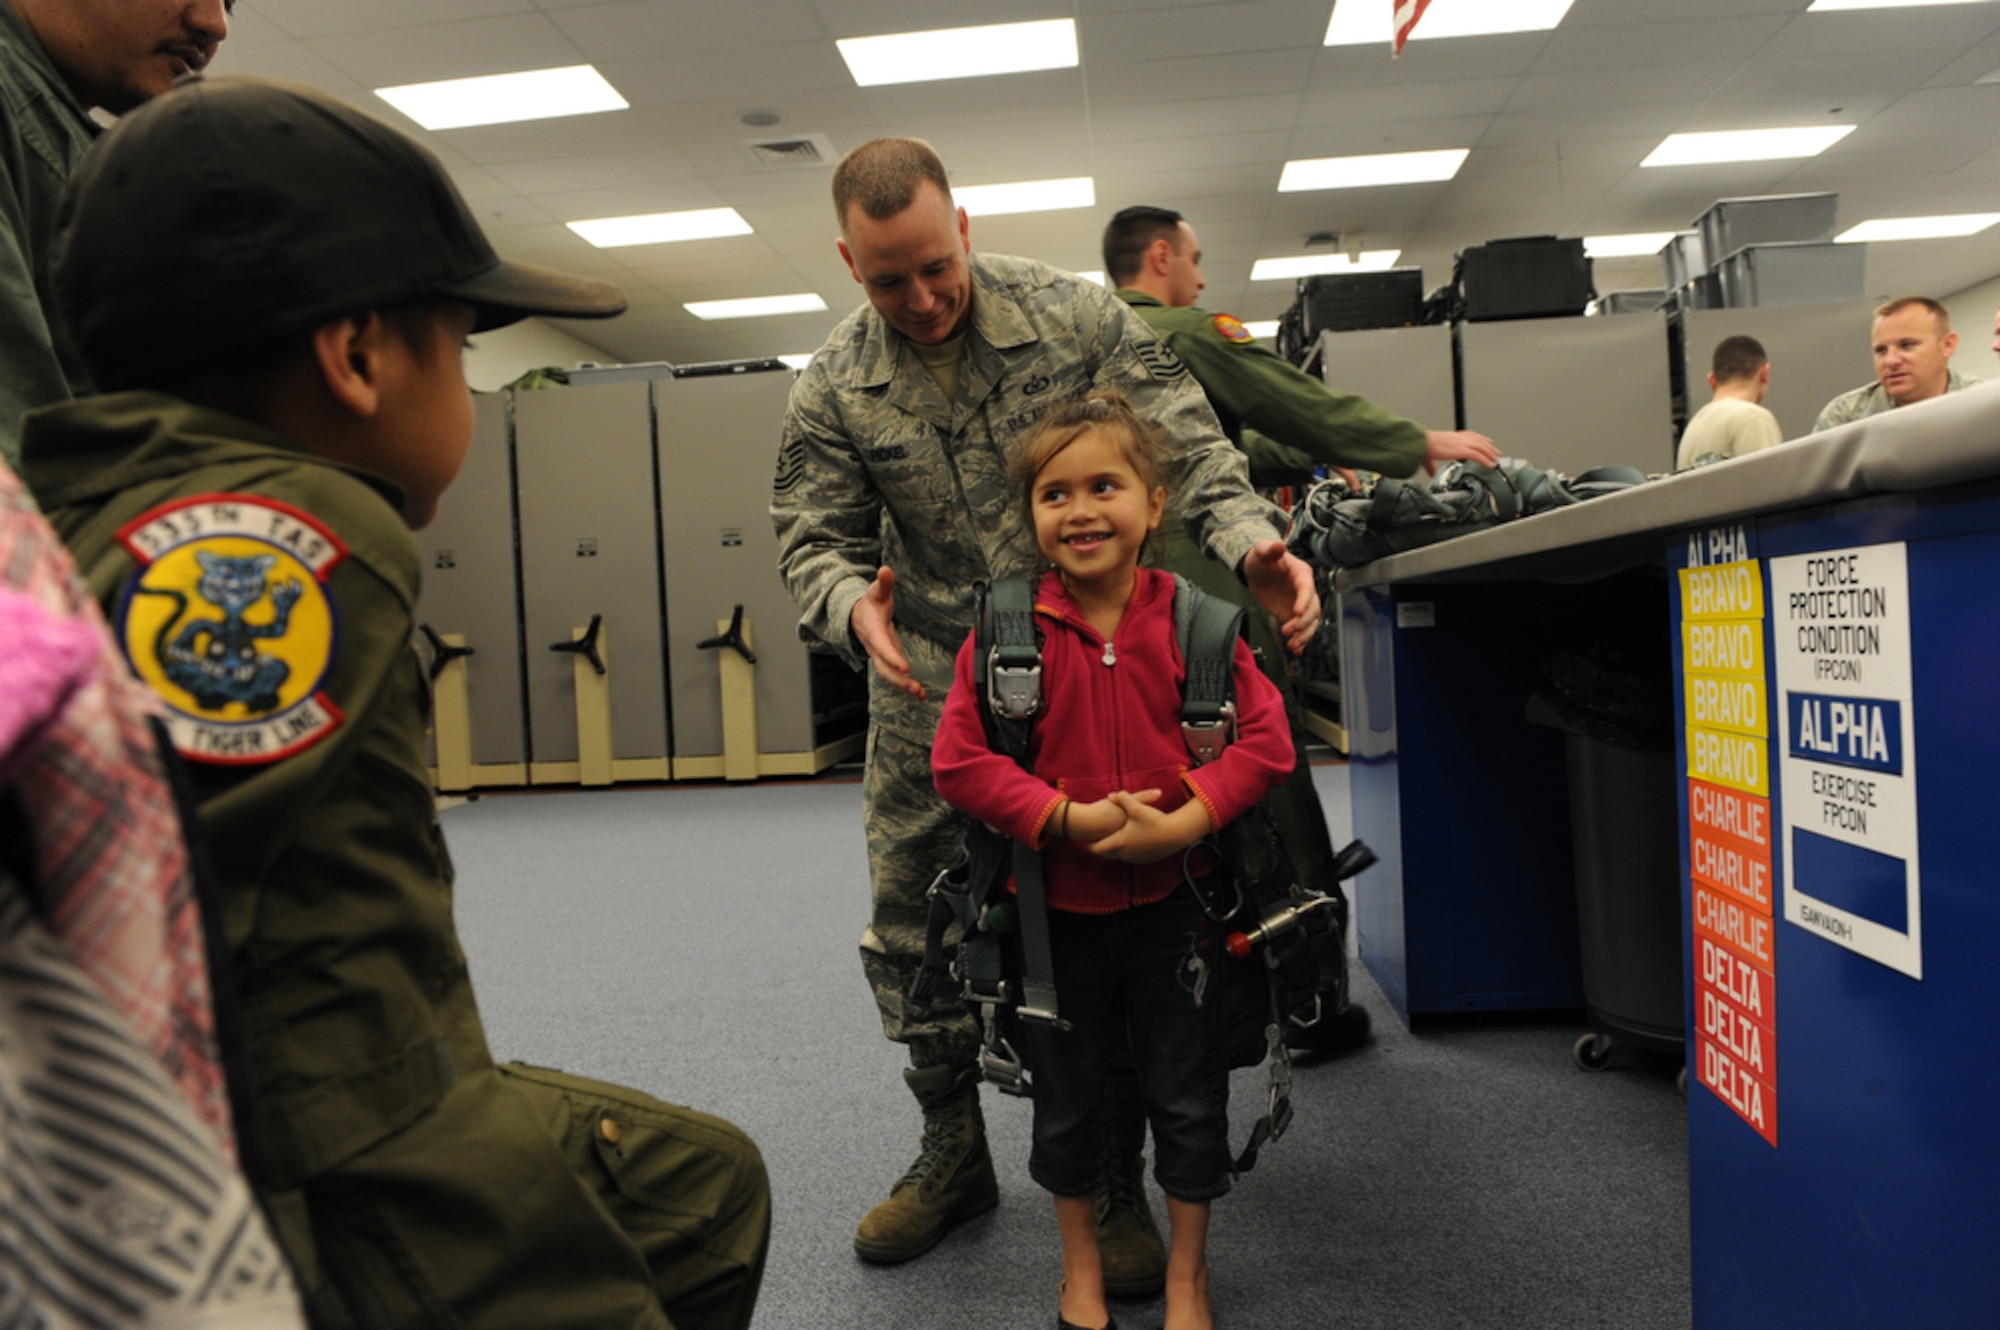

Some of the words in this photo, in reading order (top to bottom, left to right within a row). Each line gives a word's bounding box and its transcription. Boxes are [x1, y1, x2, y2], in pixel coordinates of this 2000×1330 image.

[268, 515, 325, 559] TAS
[1687, 525, 1748, 569] ALPHA
[1688, 567, 1753, 614] BRAVO
[1807, 555, 1859, 588] FORCE
[1790, 587, 1886, 620] PROTECTION
[1691, 625, 1754, 669] BRAVO
[1797, 625, 1880, 655] CONDITION
[1814, 659, 1862, 683] (FPCON)
[1693, 679, 1757, 728] BRAVO
[1800, 699, 1889, 763] ALPHA
[1695, 732, 1758, 787] BRAVO
[1812, 770, 1877, 808] EXERCISE
[1693, 786, 1766, 845] CHARLIE
[1823, 801, 1867, 835] FPCON
[1694, 838, 1768, 905] CHARLIE
[1696, 889, 1769, 962] CHARLIE
[1702, 939, 1762, 1017] DELTA
[1703, 990, 1763, 1074] DELTA
[1704, 1042, 1765, 1131] DELTA
